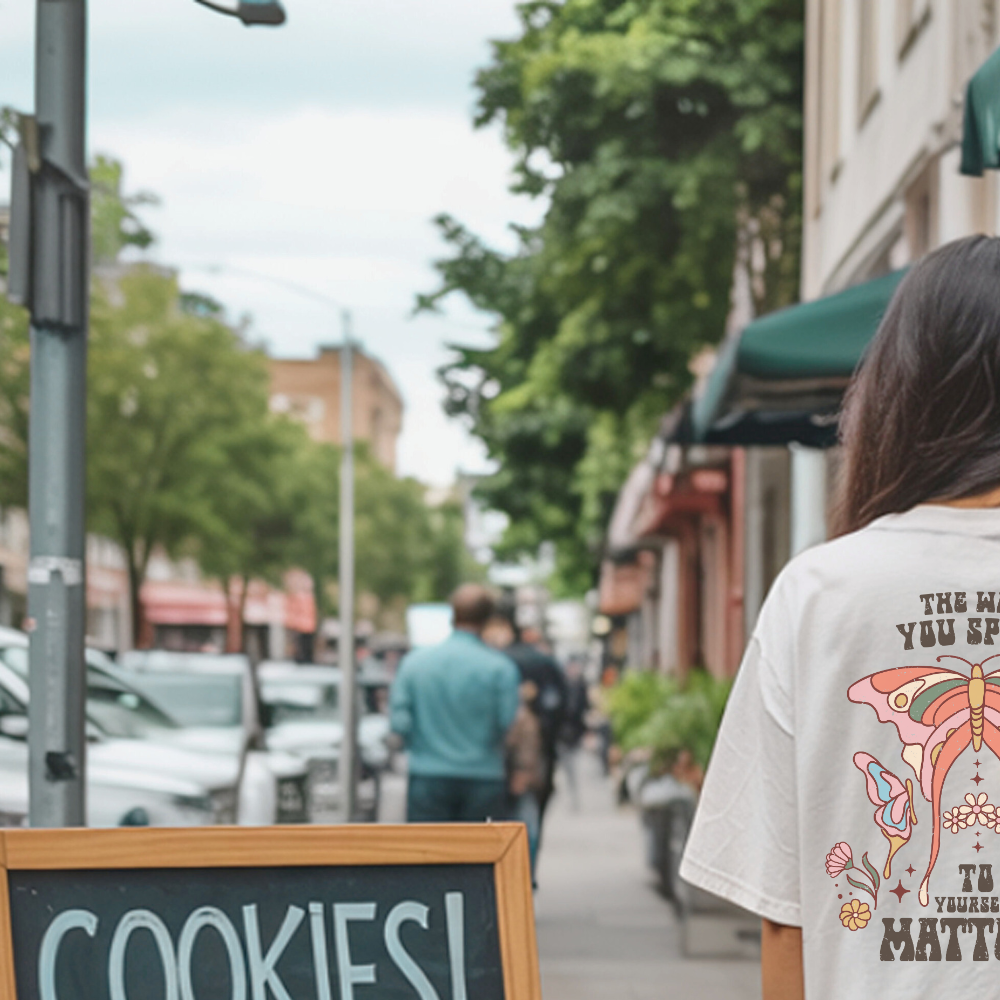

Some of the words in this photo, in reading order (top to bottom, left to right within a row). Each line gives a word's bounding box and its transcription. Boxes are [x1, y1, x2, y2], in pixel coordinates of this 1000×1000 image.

[919, 591, 968, 615] THE
[895, 618, 956, 651] YOU
[958, 863, 994, 893] TO
